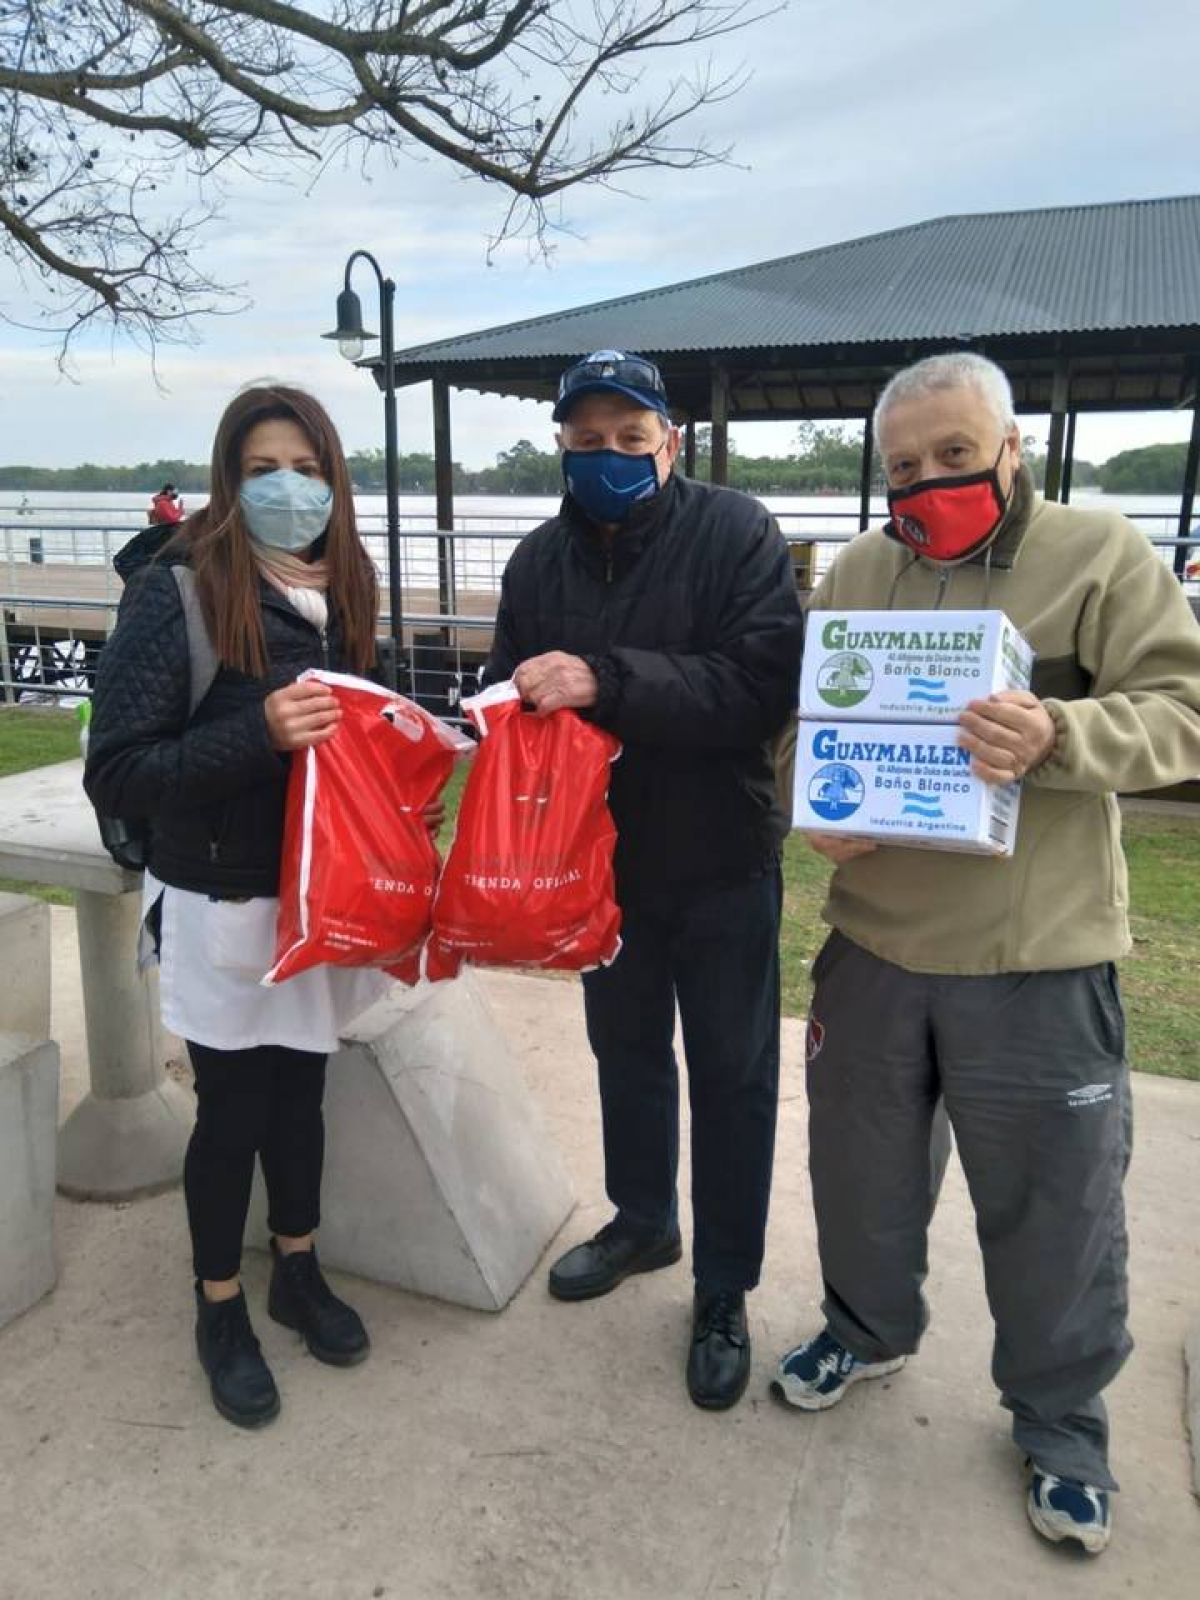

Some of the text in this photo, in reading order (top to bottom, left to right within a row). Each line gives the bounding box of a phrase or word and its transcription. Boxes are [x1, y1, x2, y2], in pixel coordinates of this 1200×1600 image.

[822, 619, 984, 650] GUAYMALLEN
[884, 663, 981, 678] Baño Blanco
[874, 776, 971, 793] Baño Blanco
